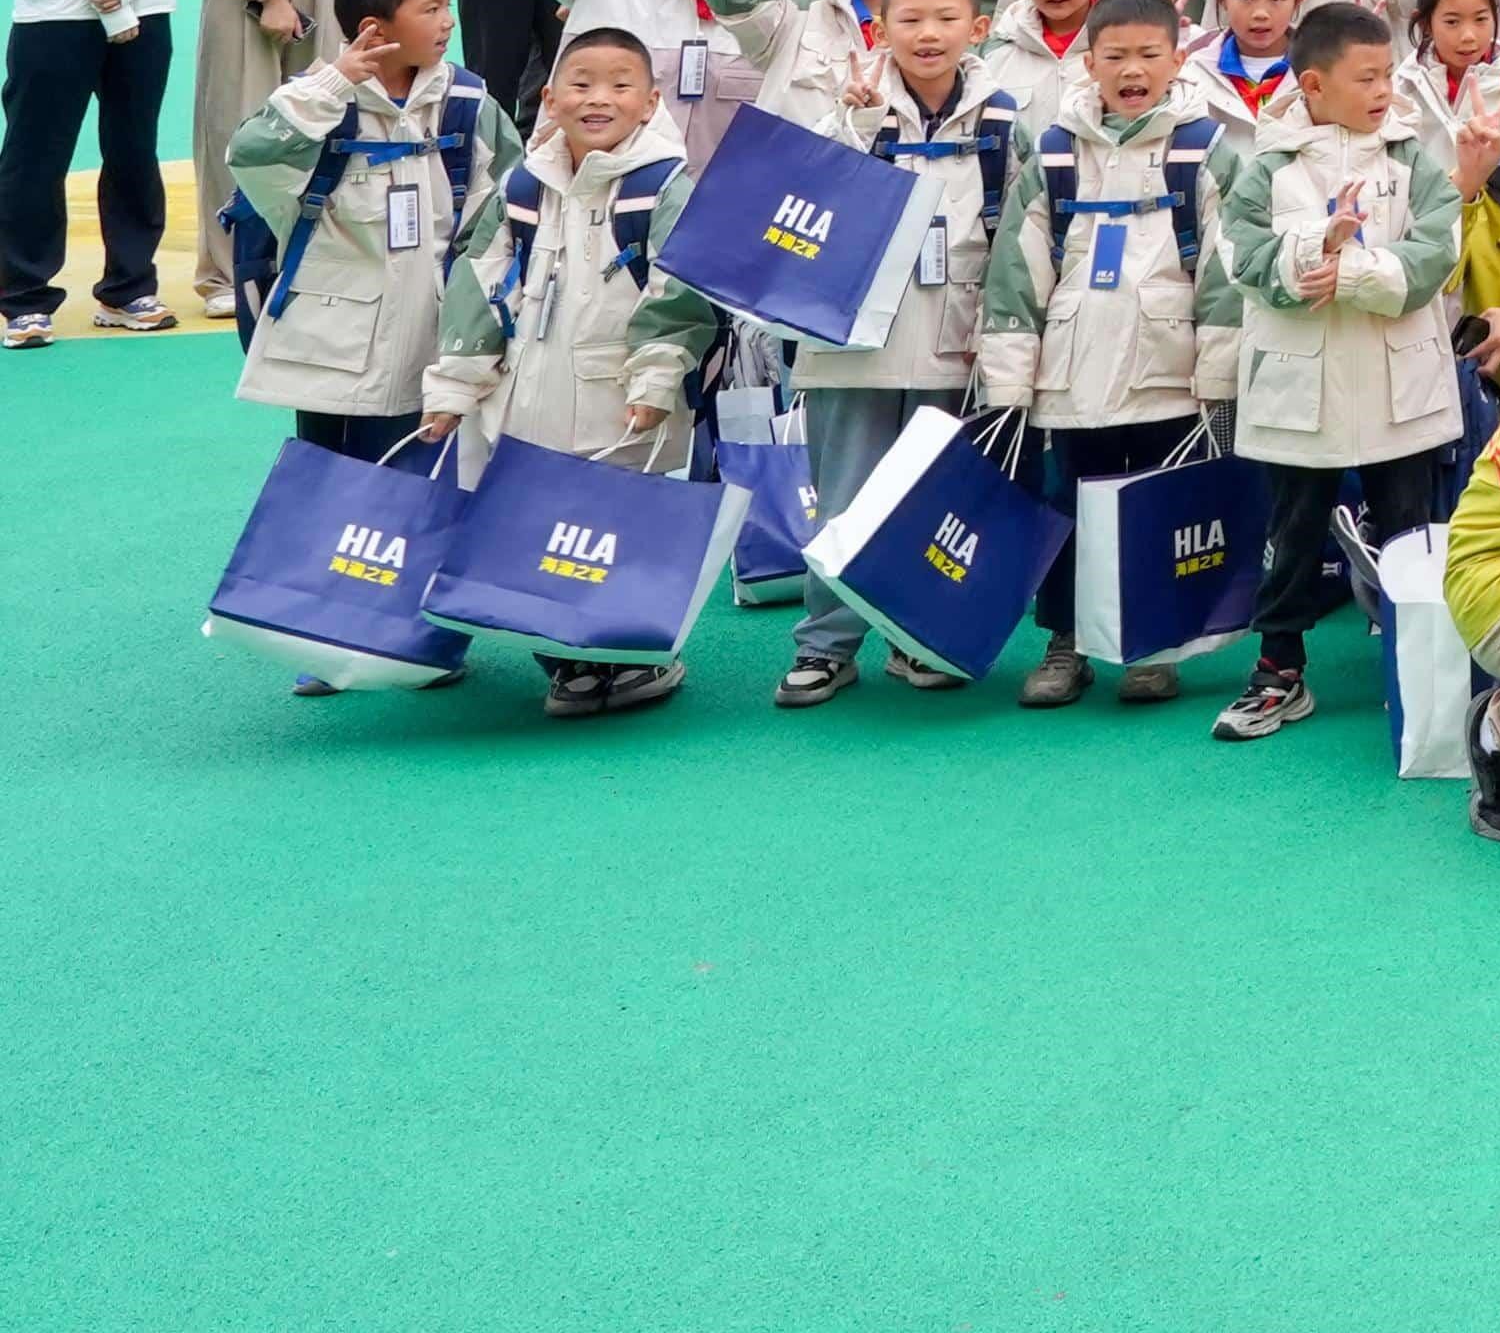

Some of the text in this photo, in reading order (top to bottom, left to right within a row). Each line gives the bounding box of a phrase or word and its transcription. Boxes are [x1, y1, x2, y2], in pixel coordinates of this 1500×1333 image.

[772, 194, 833, 242] HLA
[336, 524, 406, 568] HLA
[546, 521, 615, 565] HLA
[934, 512, 979, 566] HLA
[1174, 519, 1225, 559] HLA
